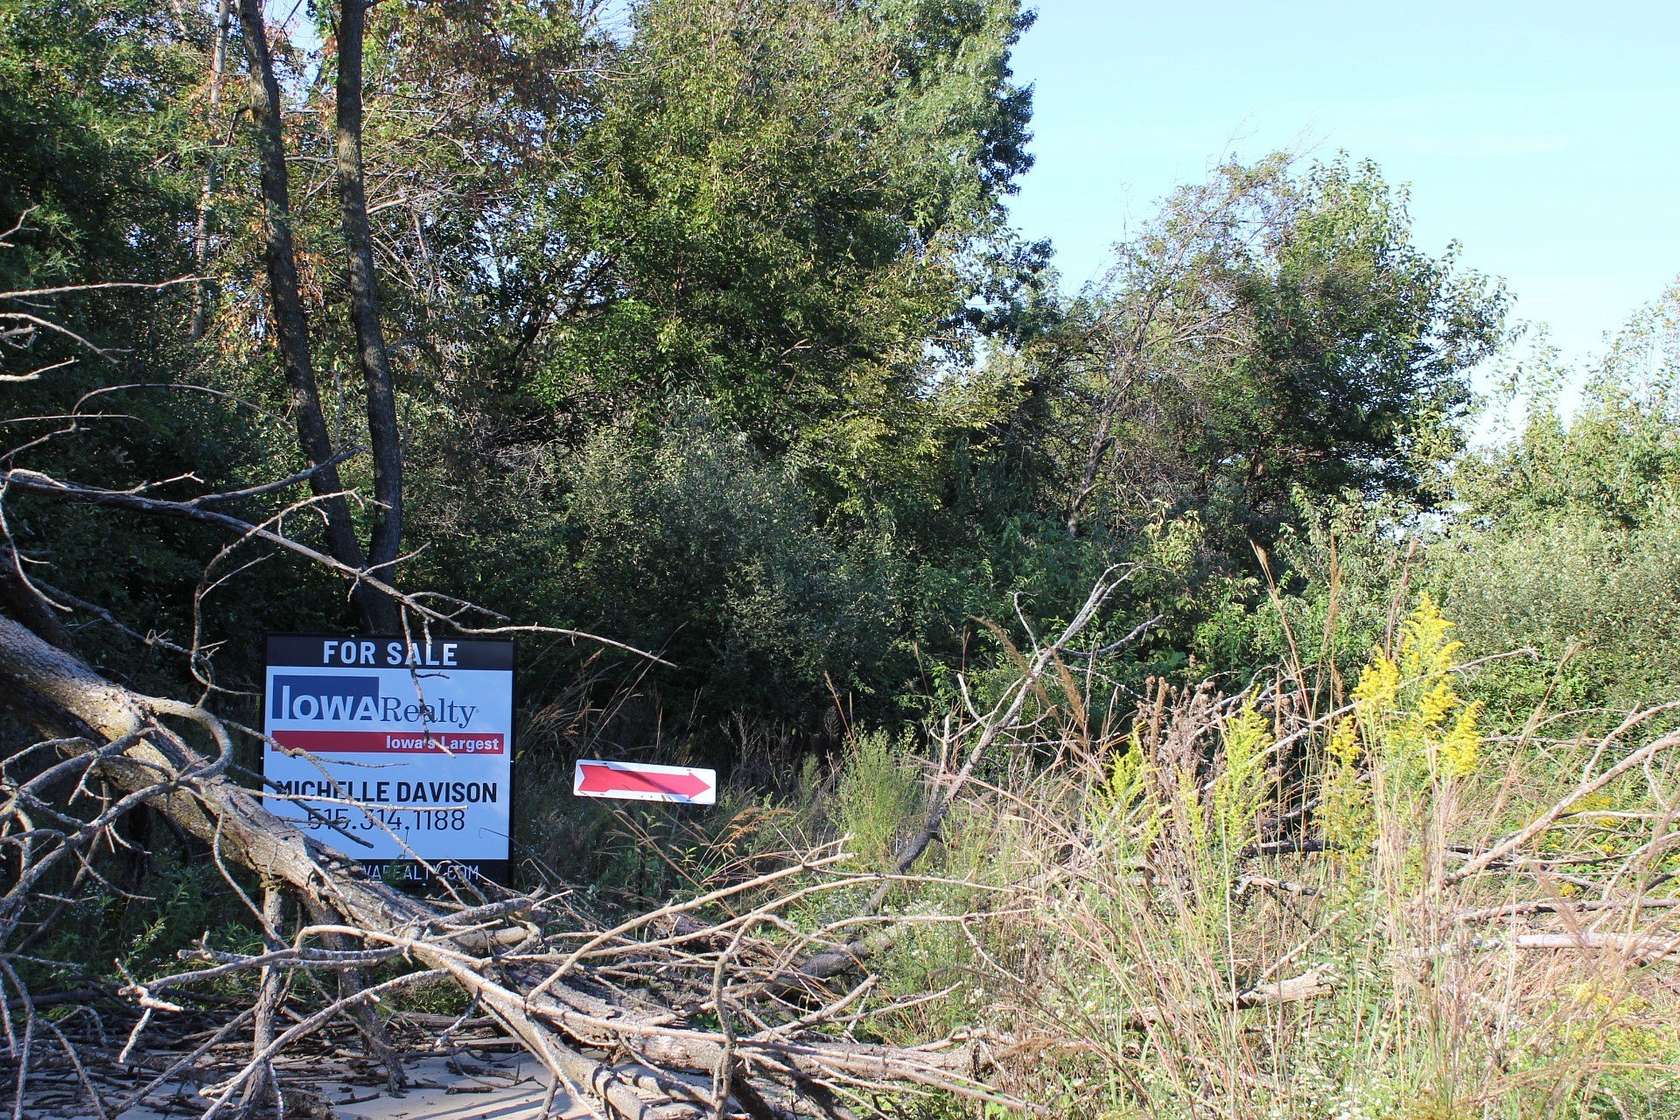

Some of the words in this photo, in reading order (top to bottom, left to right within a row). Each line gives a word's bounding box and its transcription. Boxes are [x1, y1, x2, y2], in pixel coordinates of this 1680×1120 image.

[323, 640, 376, 665] FOR
[387, 641, 458, 666] SALE
[380, 696, 476, 729] Realty
[386, 735, 437, 750] Iowa's
[441, 735, 499, 752] Largest
[276, 780, 390, 802] MICHELLE
[396, 782, 497, 803] DAVISON
